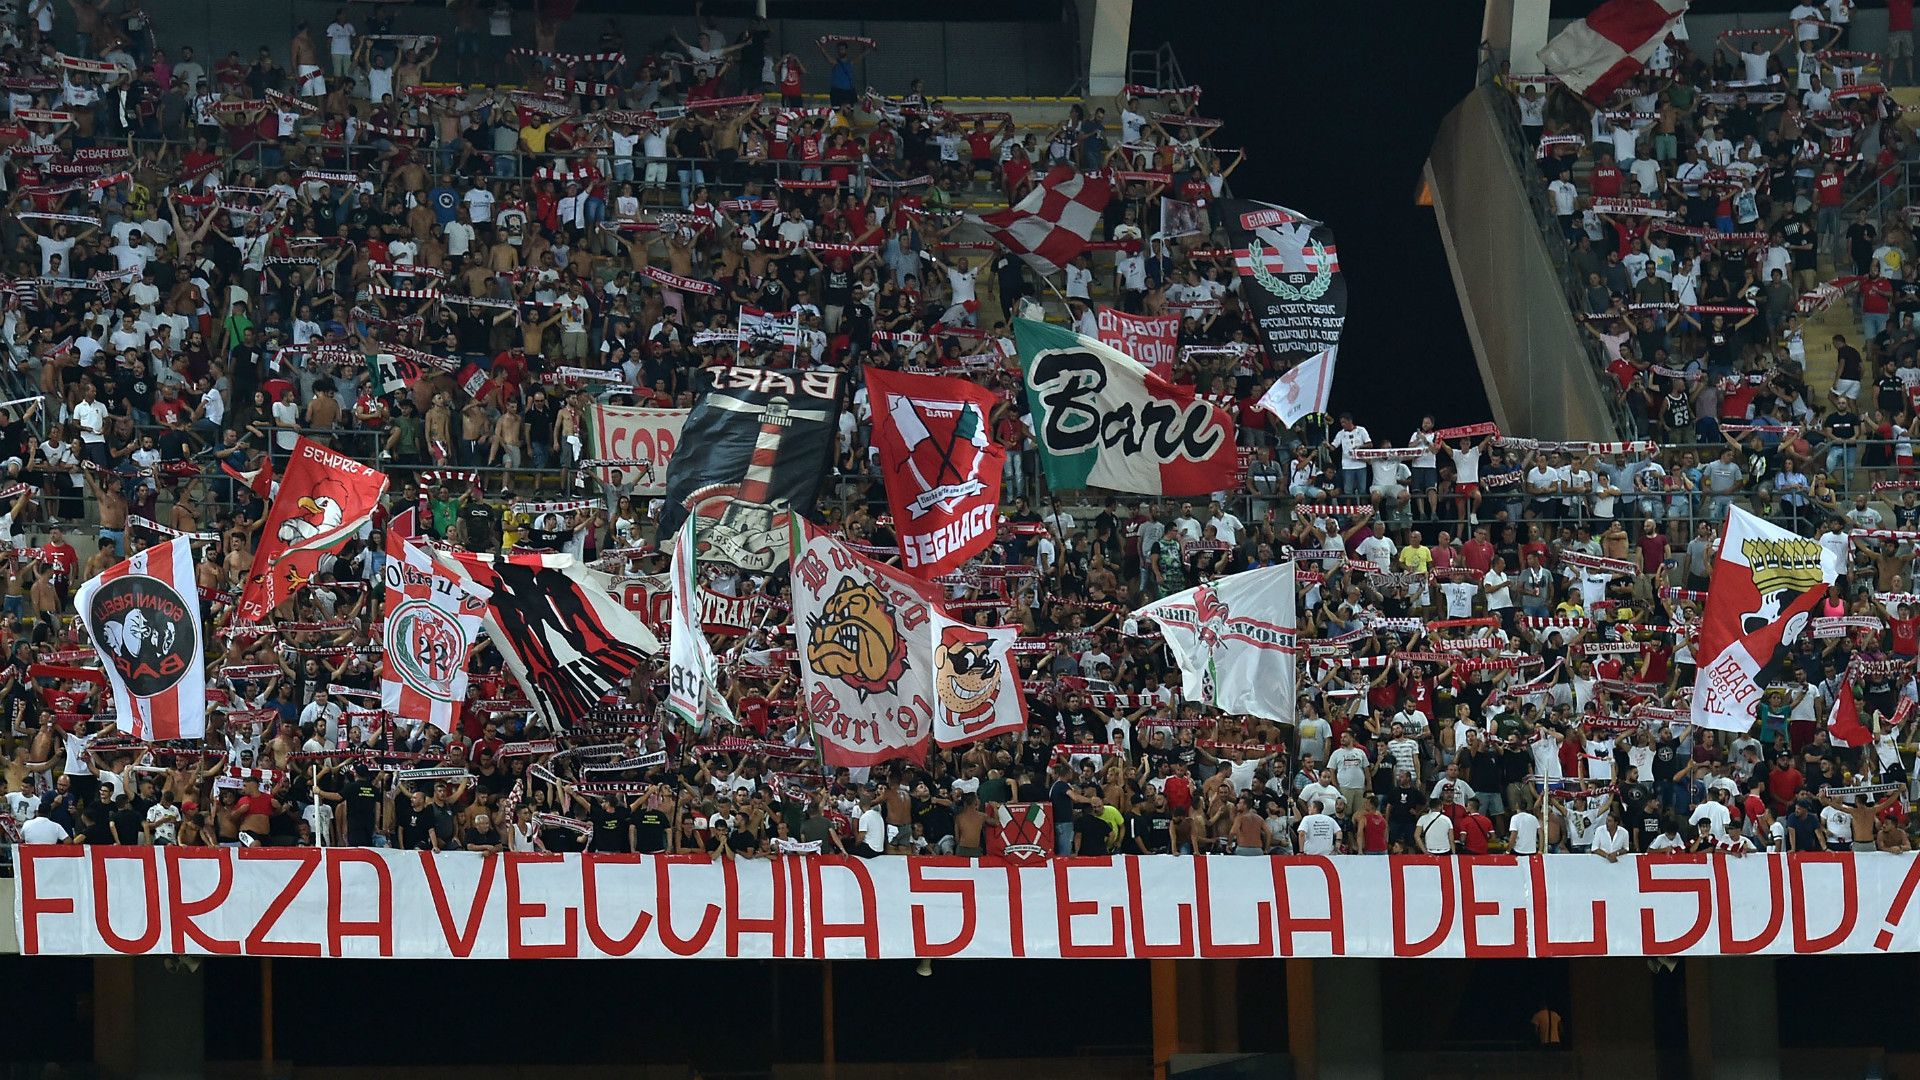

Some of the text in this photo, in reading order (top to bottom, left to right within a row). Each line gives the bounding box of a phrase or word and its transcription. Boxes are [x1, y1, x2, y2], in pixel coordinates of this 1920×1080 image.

[51, 164, 62, 172] FC
[64, 165, 83, 173] BARI
[76, 151, 88, 159] FC
[89, 151, 109, 159] BARI
[1247, 211, 1281, 226] GIANNI
[651, 270, 704, 291] FORZA BARI
[1289, 274, 1307, 284] 1991
[777, 314, 794, 326] 40
[1098, 310, 1180, 340] di padre
[1128, 335, 1174, 367] figlio
[303, 445, 362, 476] SEMPRE
[611, 427, 677, 468] COR
[903, 503, 995, 568] SEGUACI
[386, 562, 432, 587] Oltre
[696, 583, 755, 629] STRAN
[419, 635, 447, 672] 22
[1442, 639, 1493, 650] SEGUACI
[1416, 688, 1426, 701] 7
[811, 681, 883, 746] Bari
[16, 845, 1920, 960] FORZA VECCHIA STELLA DEL SUD!
